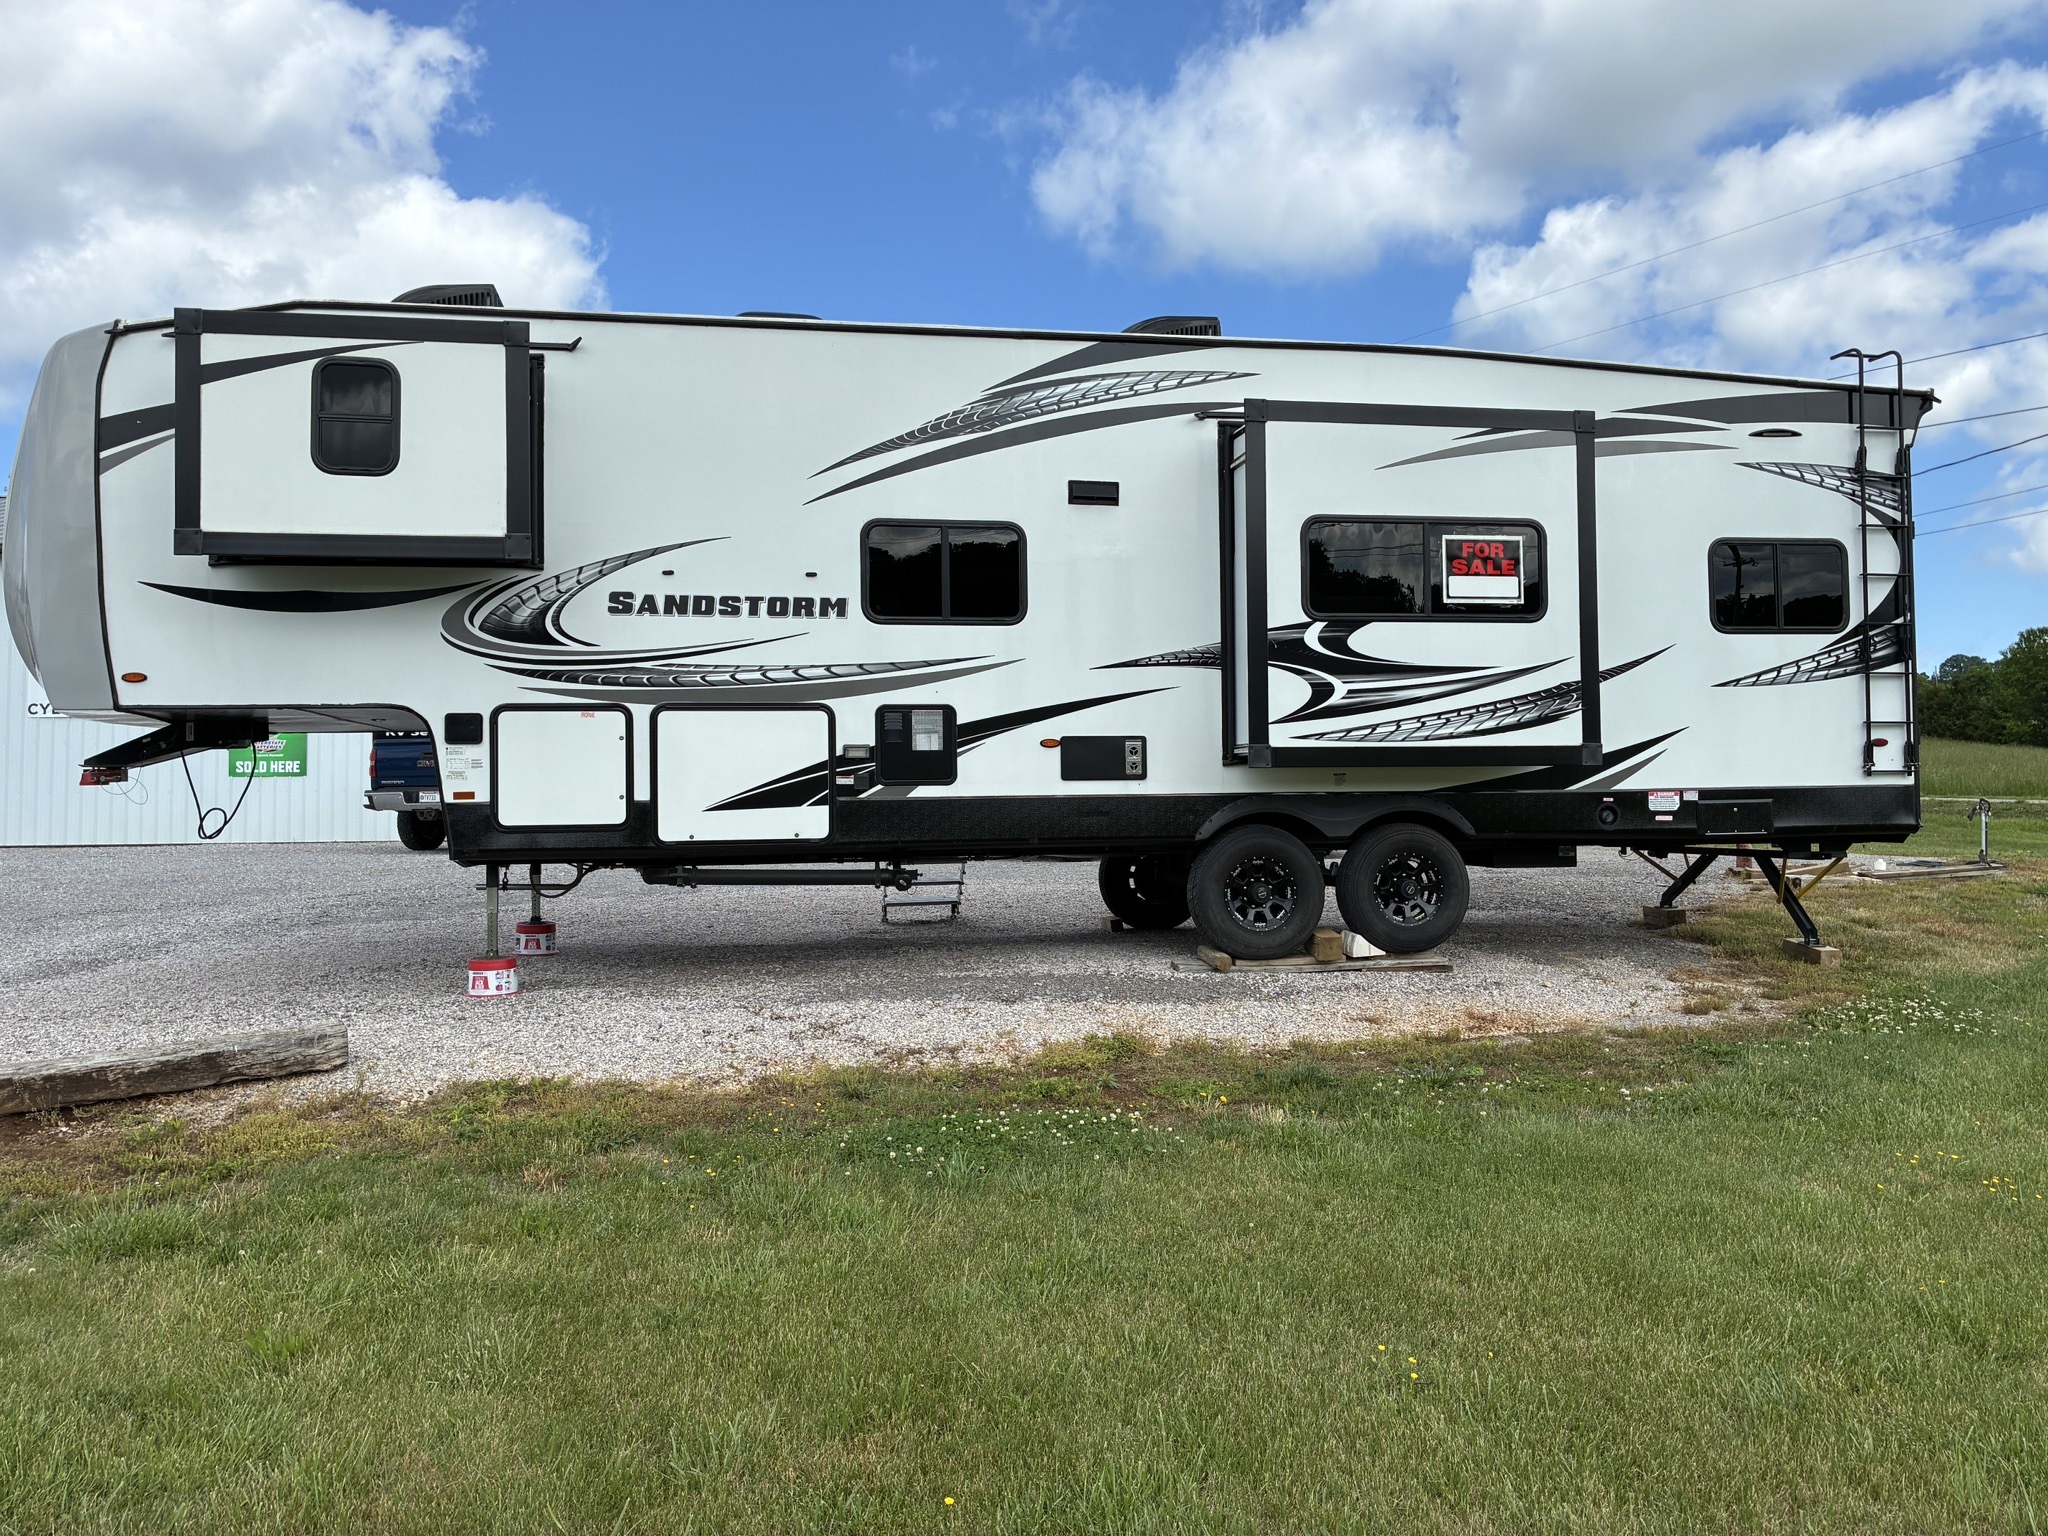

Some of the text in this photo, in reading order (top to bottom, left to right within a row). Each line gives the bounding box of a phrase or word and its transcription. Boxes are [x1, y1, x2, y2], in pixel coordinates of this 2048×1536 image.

[1462, 542, 1504, 558] FOR
[1452, 559, 1515, 575] SALE
[607, 591, 850, 619] SANDSTORM
[235, 760, 301, 773] SOLD HERE
